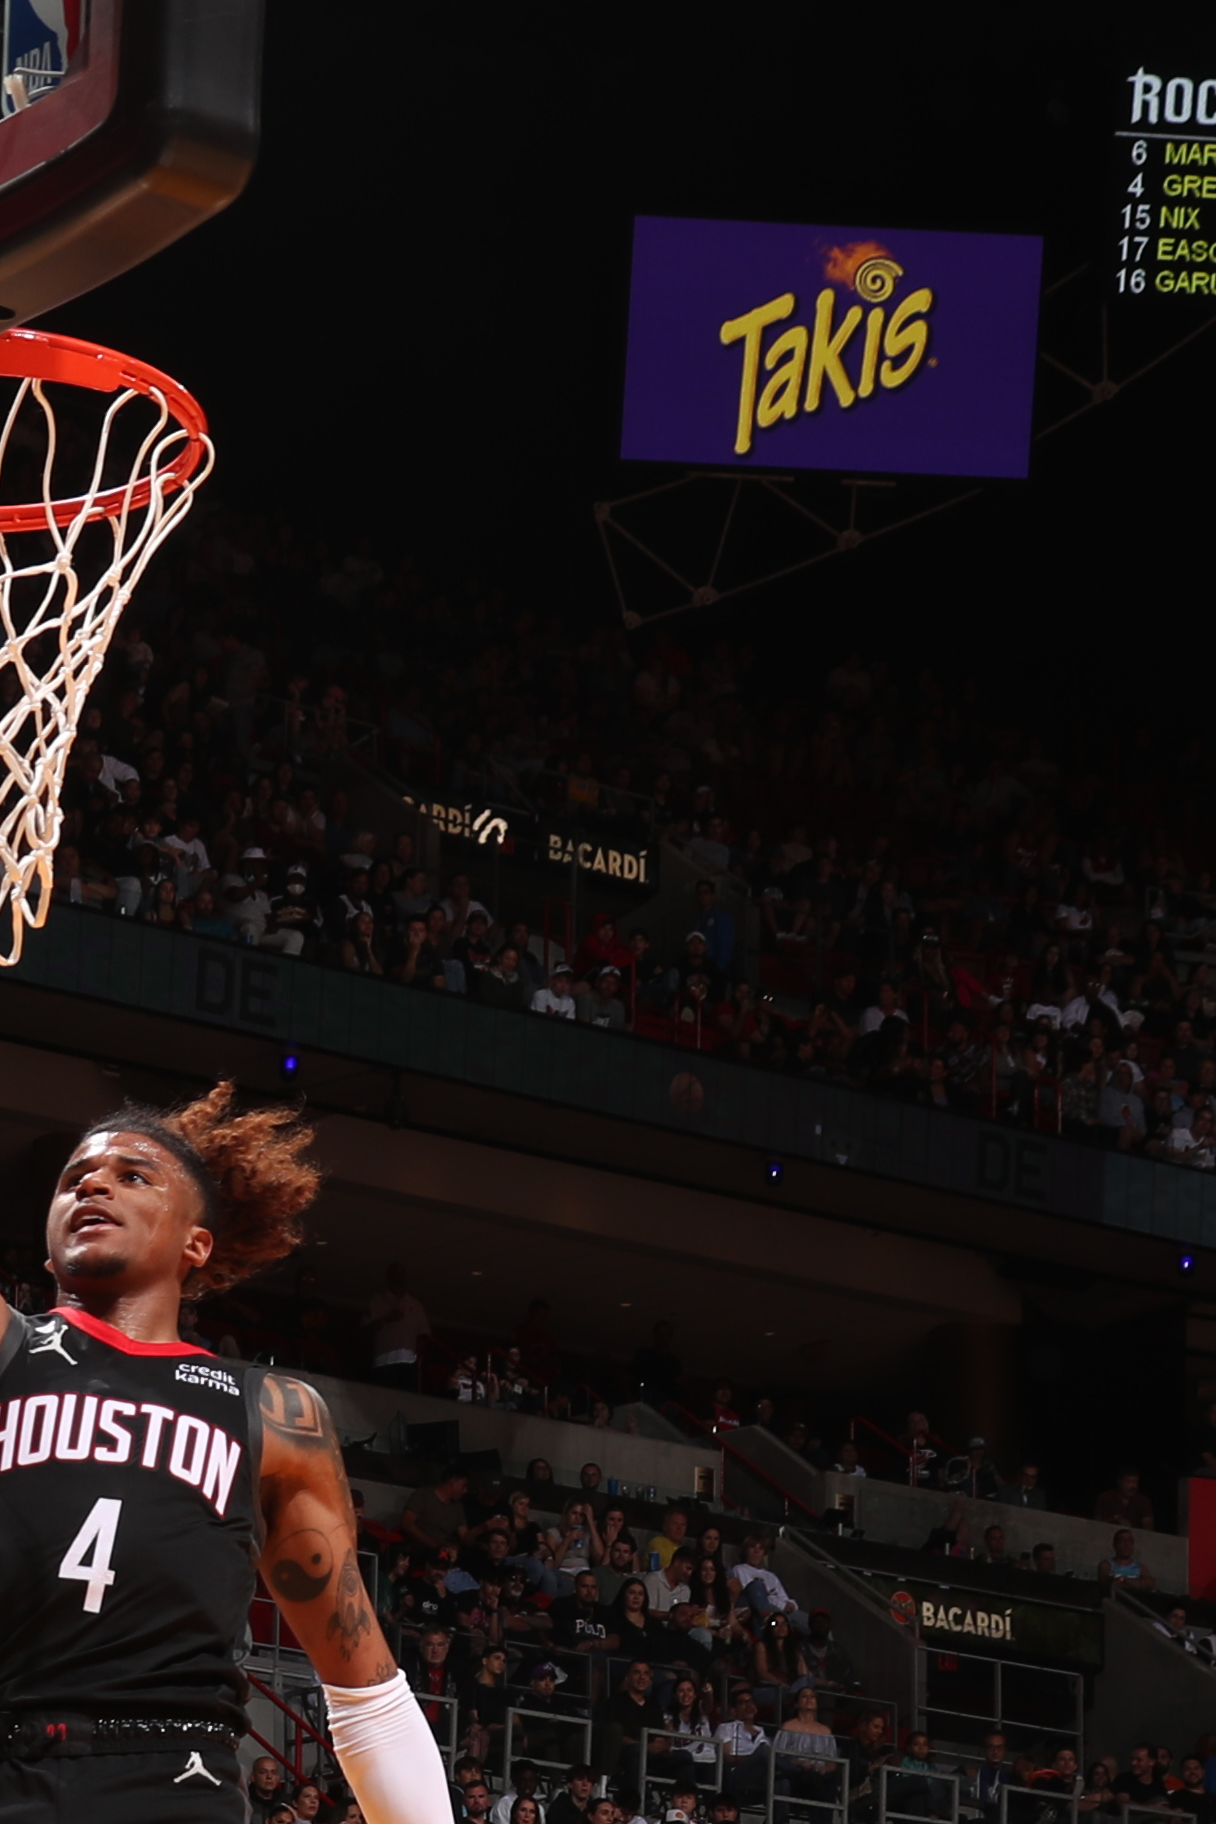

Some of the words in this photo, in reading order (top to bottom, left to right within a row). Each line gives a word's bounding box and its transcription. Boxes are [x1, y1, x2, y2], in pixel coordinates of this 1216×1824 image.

[1131, 141, 1147, 165] 6
[1127, 174, 1144, 198] 4
[1163, 175, 1216, 199] GRE
[1121, 205, 1151, 229] 15
[1160, 207, 1200, 231] NIX
[1119, 236, 1148, 261] 17
[1116, 268, 1145, 294] 16
[720, 285, 932, 455] Takis
[175, 1371, 240, 1396] karma
[178, 1363, 235, 1386] credit
[58, 1497, 123, 1614] 4
[921, 1600, 1013, 1642] BACARDÍ
